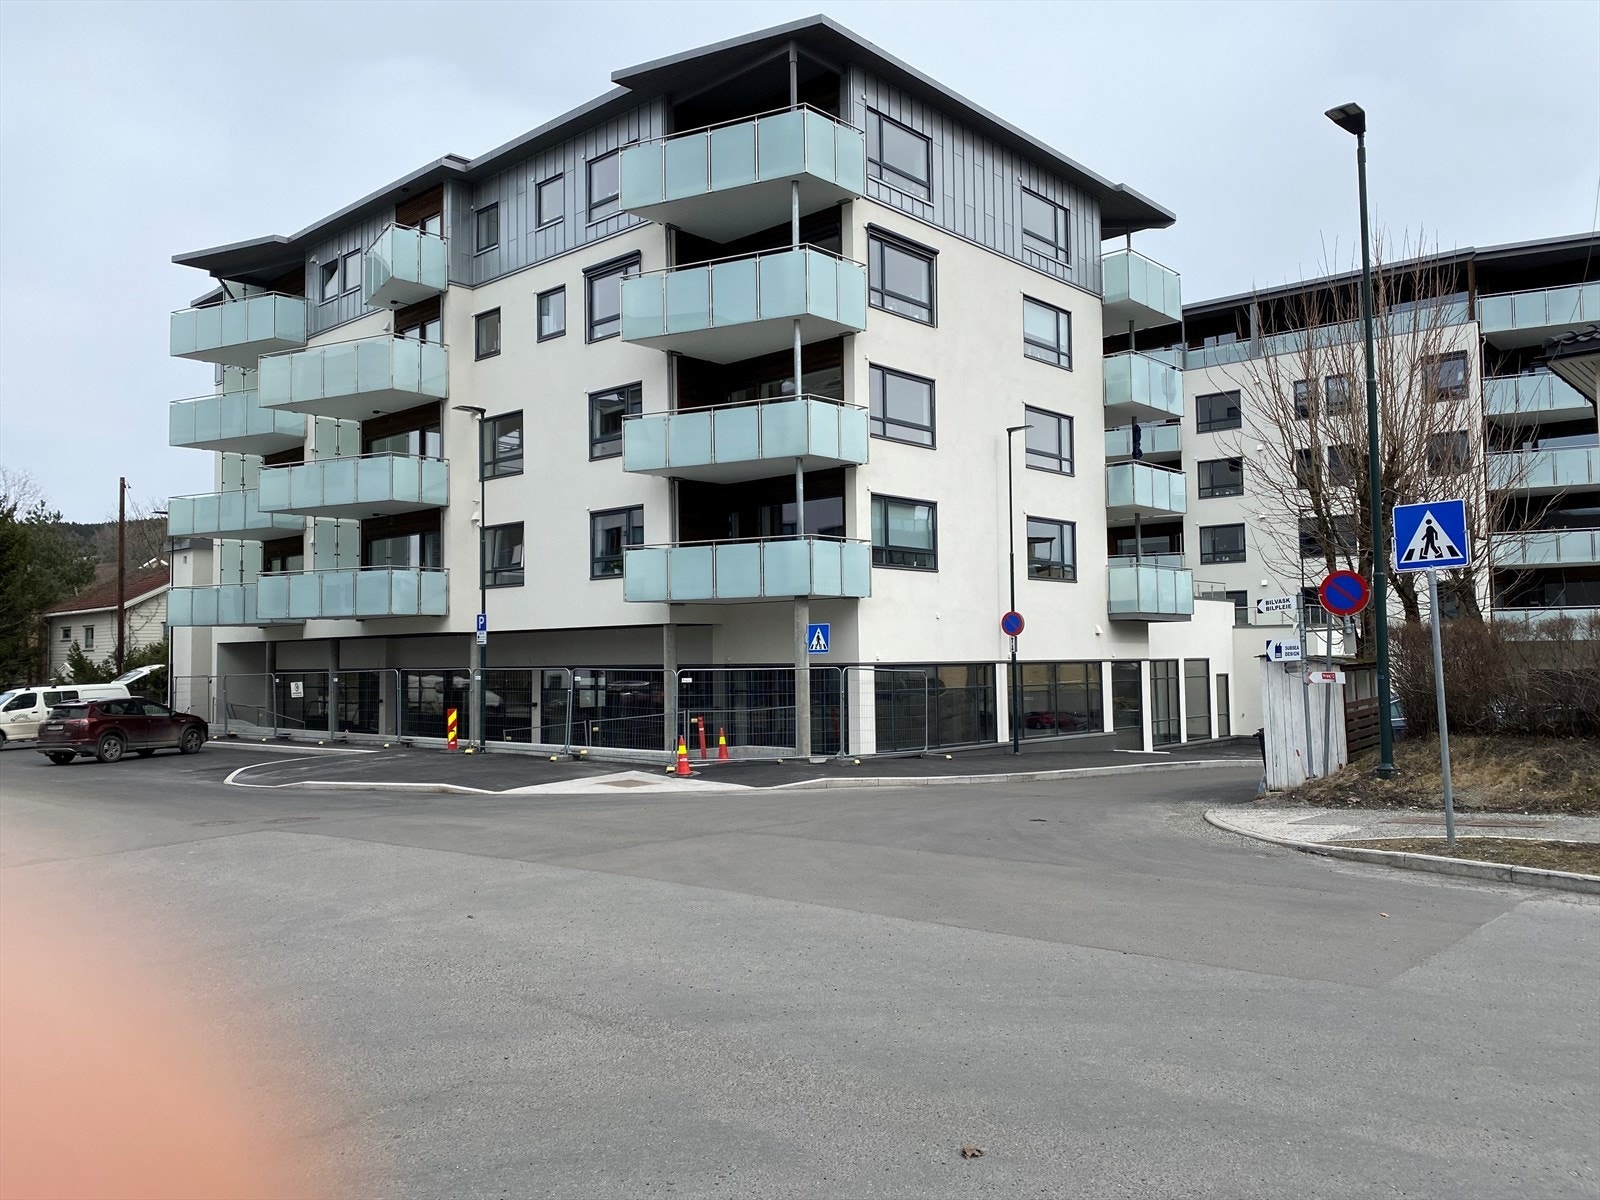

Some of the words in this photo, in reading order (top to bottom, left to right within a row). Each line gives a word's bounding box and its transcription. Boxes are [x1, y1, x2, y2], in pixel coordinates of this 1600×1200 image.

[1265, 598, 1291, 606] BILVASK
[1265, 604, 1292, 612] BILPLEIE
[478, 616, 485, 629] P
